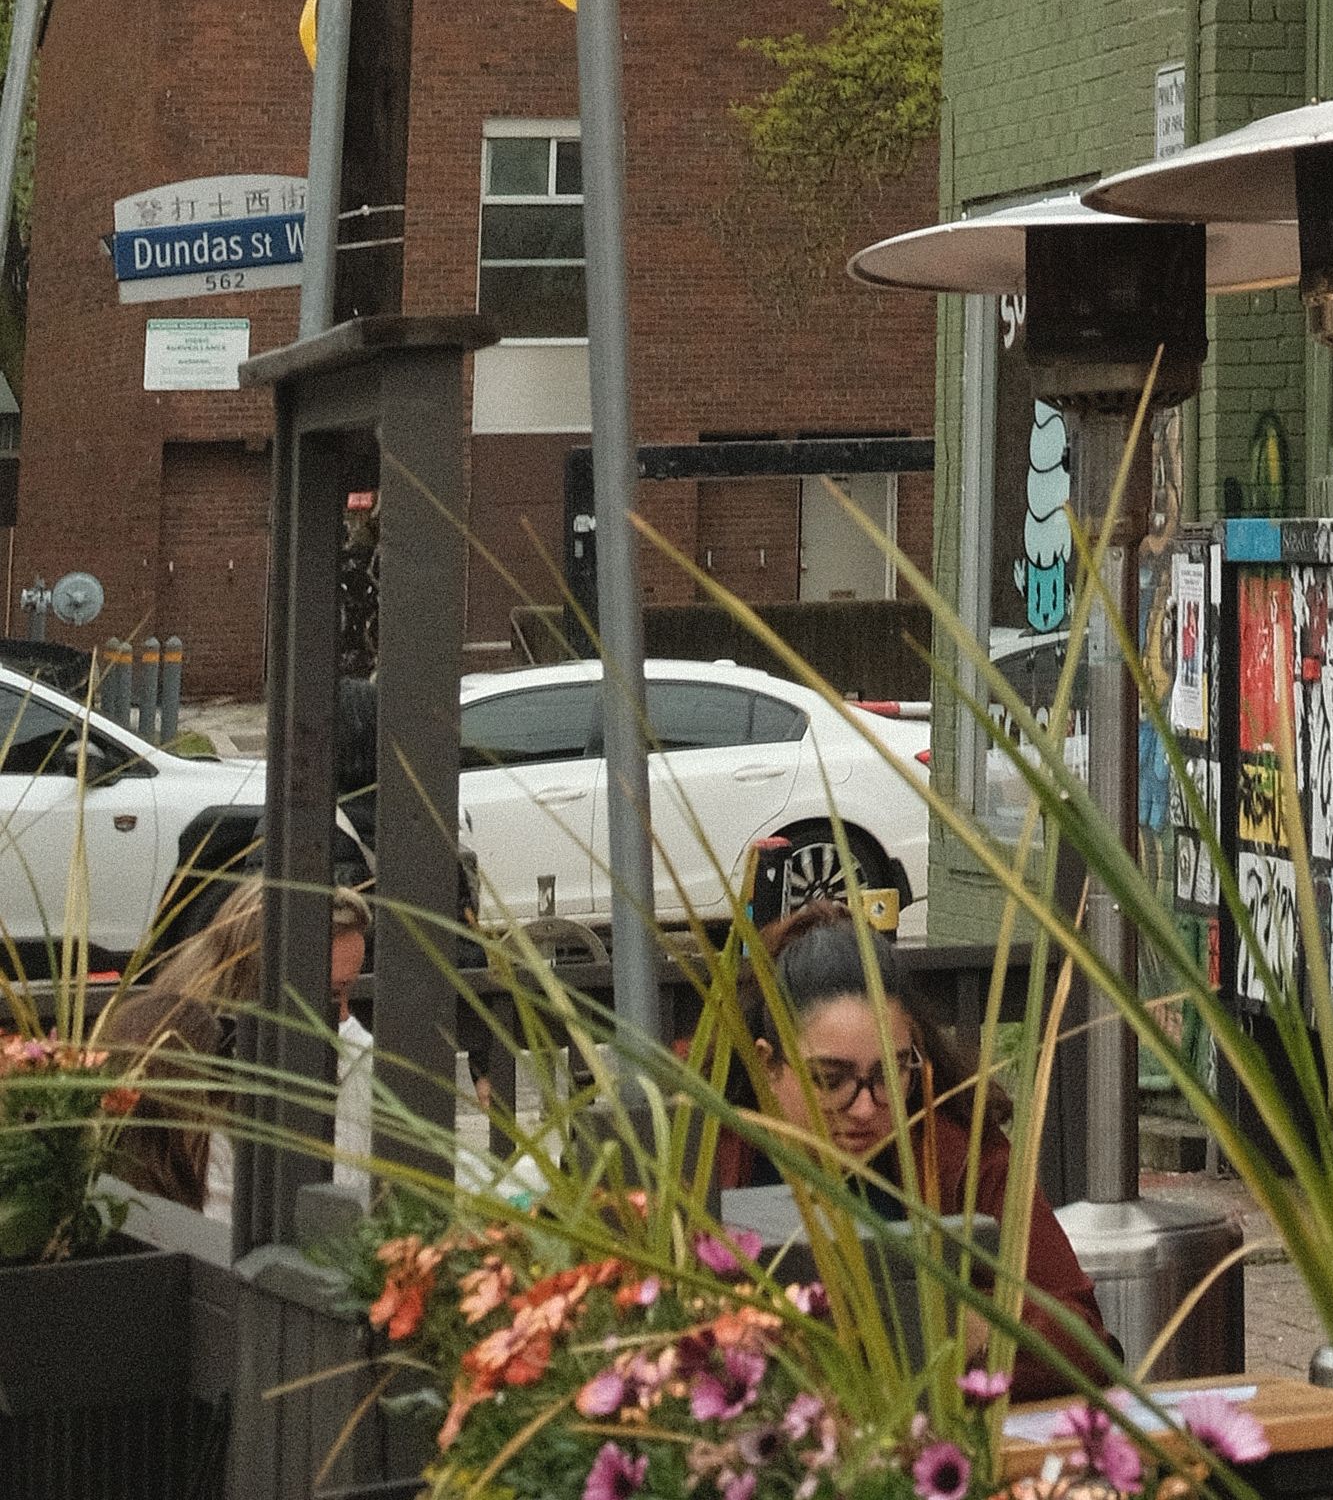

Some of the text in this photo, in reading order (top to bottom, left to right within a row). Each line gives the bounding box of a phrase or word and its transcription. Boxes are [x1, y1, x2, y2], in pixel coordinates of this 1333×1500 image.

[134, 231, 243, 270] Dundas
[251, 232, 273, 259] St
[205, 272, 245, 292] 562
